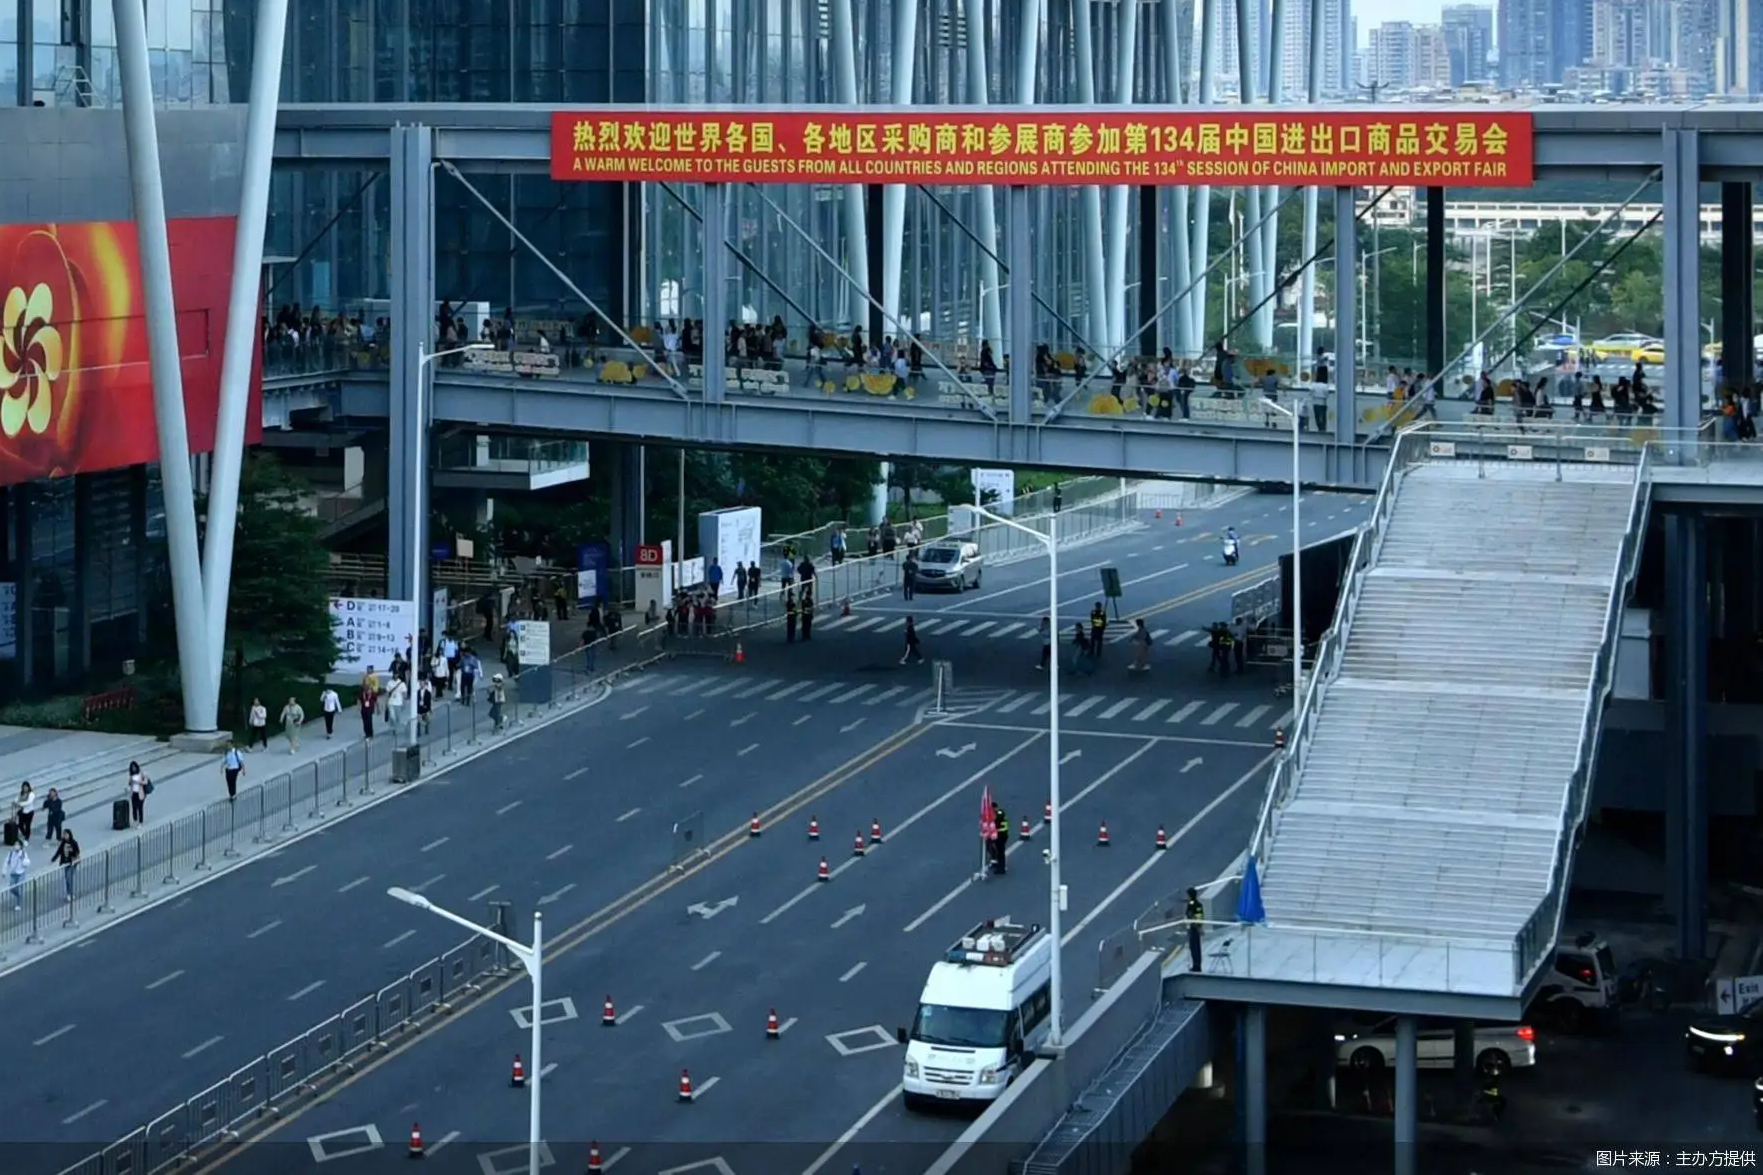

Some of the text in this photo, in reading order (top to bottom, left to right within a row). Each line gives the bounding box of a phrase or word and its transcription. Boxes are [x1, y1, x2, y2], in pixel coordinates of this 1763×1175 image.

[573, 121, 1508, 156] 热烈欢迎世界各国、各地区采购商和参展商参加第134届中国进出口商品交易会
[573, 158, 582, 171] A
[585, 157, 626, 172] WARM
[627, 158, 692, 173] WELCOME
[695, 158, 713, 173] TO
[715, 158, 740, 173] THE
[742, 159, 796, 174] GUESTS
[798, 159, 836, 174] FROM
[838, 159, 863, 174] ALL
[865, 159, 943, 175] COUNTRIES
[945, 160, 975, 175] AND
[976, 160, 1038, 175] REGIONS
[1040, 160, 1121, 176] ATTENDING
[1123, 160, 1150, 176] THE
[1186, 160, 1249, 176] SESSION
[1251, 160, 1271, 176] OF
[1273, 160, 1318, 176] CHINA
[1320, 160, 1376, 176] IMPORT
[1379, 161, 1411, 176] AND
[1413, 161, 1471, 177] EXPORT
[1474, 161, 1507, 177] FAIR
[640, 548, 658, 562] 8D
[347, 600, 356, 611] D
[346, 617, 355, 627] A
[347, 629, 355, 640] B
